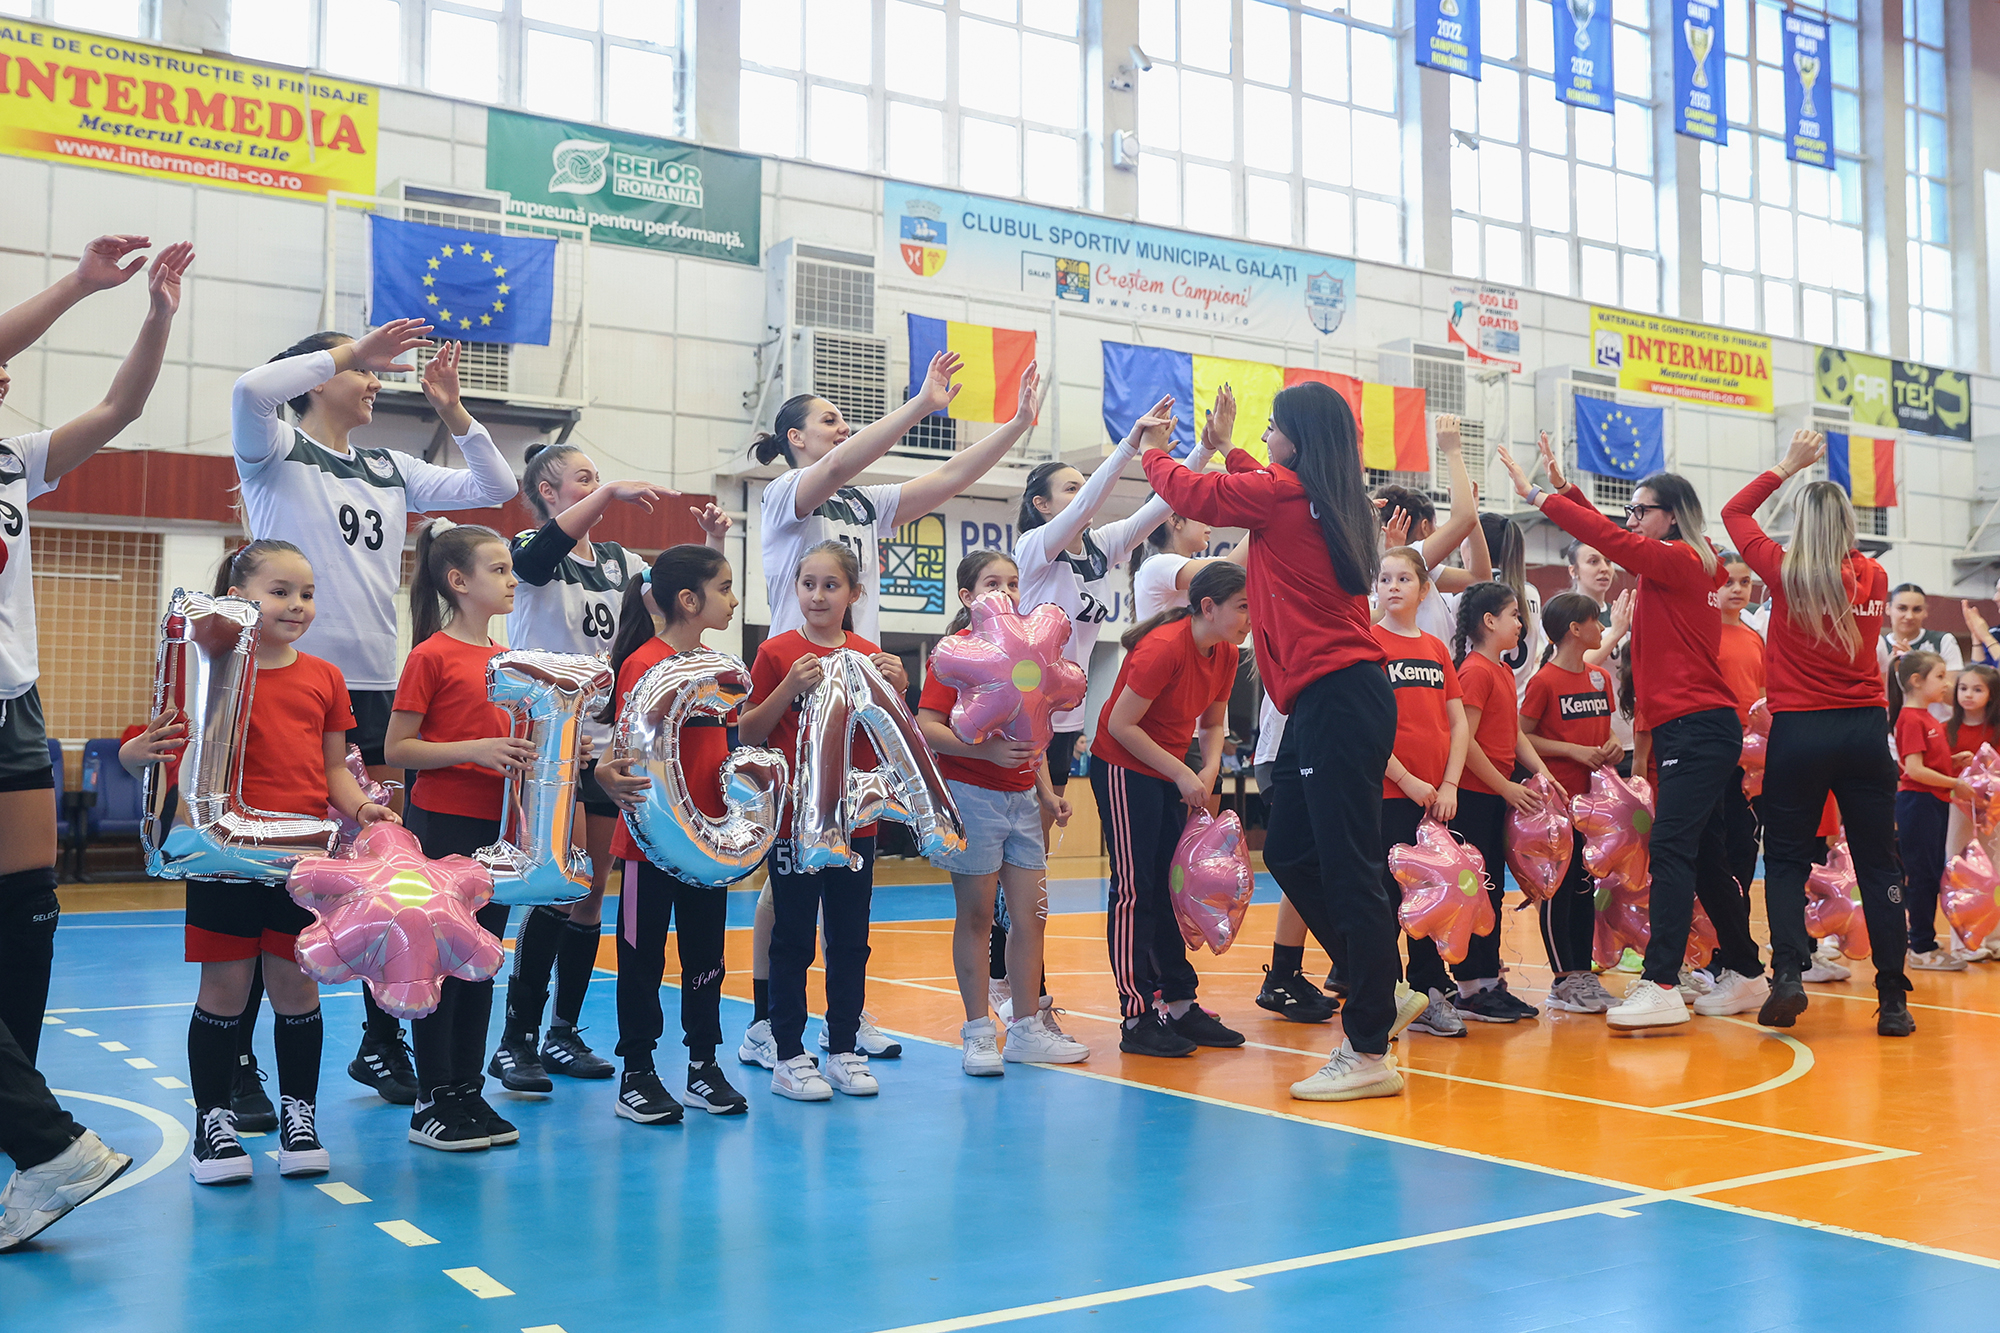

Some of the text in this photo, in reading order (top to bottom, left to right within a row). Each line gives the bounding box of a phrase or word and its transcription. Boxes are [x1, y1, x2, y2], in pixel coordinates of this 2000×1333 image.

[1437, 18, 1462, 42] 2022
[53, 36, 81, 54] DE
[90, 44, 244, 83] CONSTRUCȚIE
[279, 79, 369, 106] FINISAJE
[1571, 55, 1594, 77] 2022
[188, 134, 242, 155] casei
[249, 144, 290, 162] tale
[55, 138, 303, 191] www.intermedia-co.ro
[615, 155, 702, 188] BELOR
[618, 179, 699, 205] ROMANIA
[588, 211, 643, 234] pentru
[962, 211, 1298, 287] CLUBUL SPORTIV MUNICIPAL GALAȚI
[1172, 275, 1252, 310] Campioni!
[1502, 297, 1518, 310] LEI
[1479, 315, 1519, 332] GRATIS
[1627, 334, 1768, 380] INTERMEDIA
[339, 504, 383, 551] 93
[1560, 697, 1608, 718] Kempa
[32, 909, 59, 922] SELECT
[194, 1009, 239, 1029] Kempa
